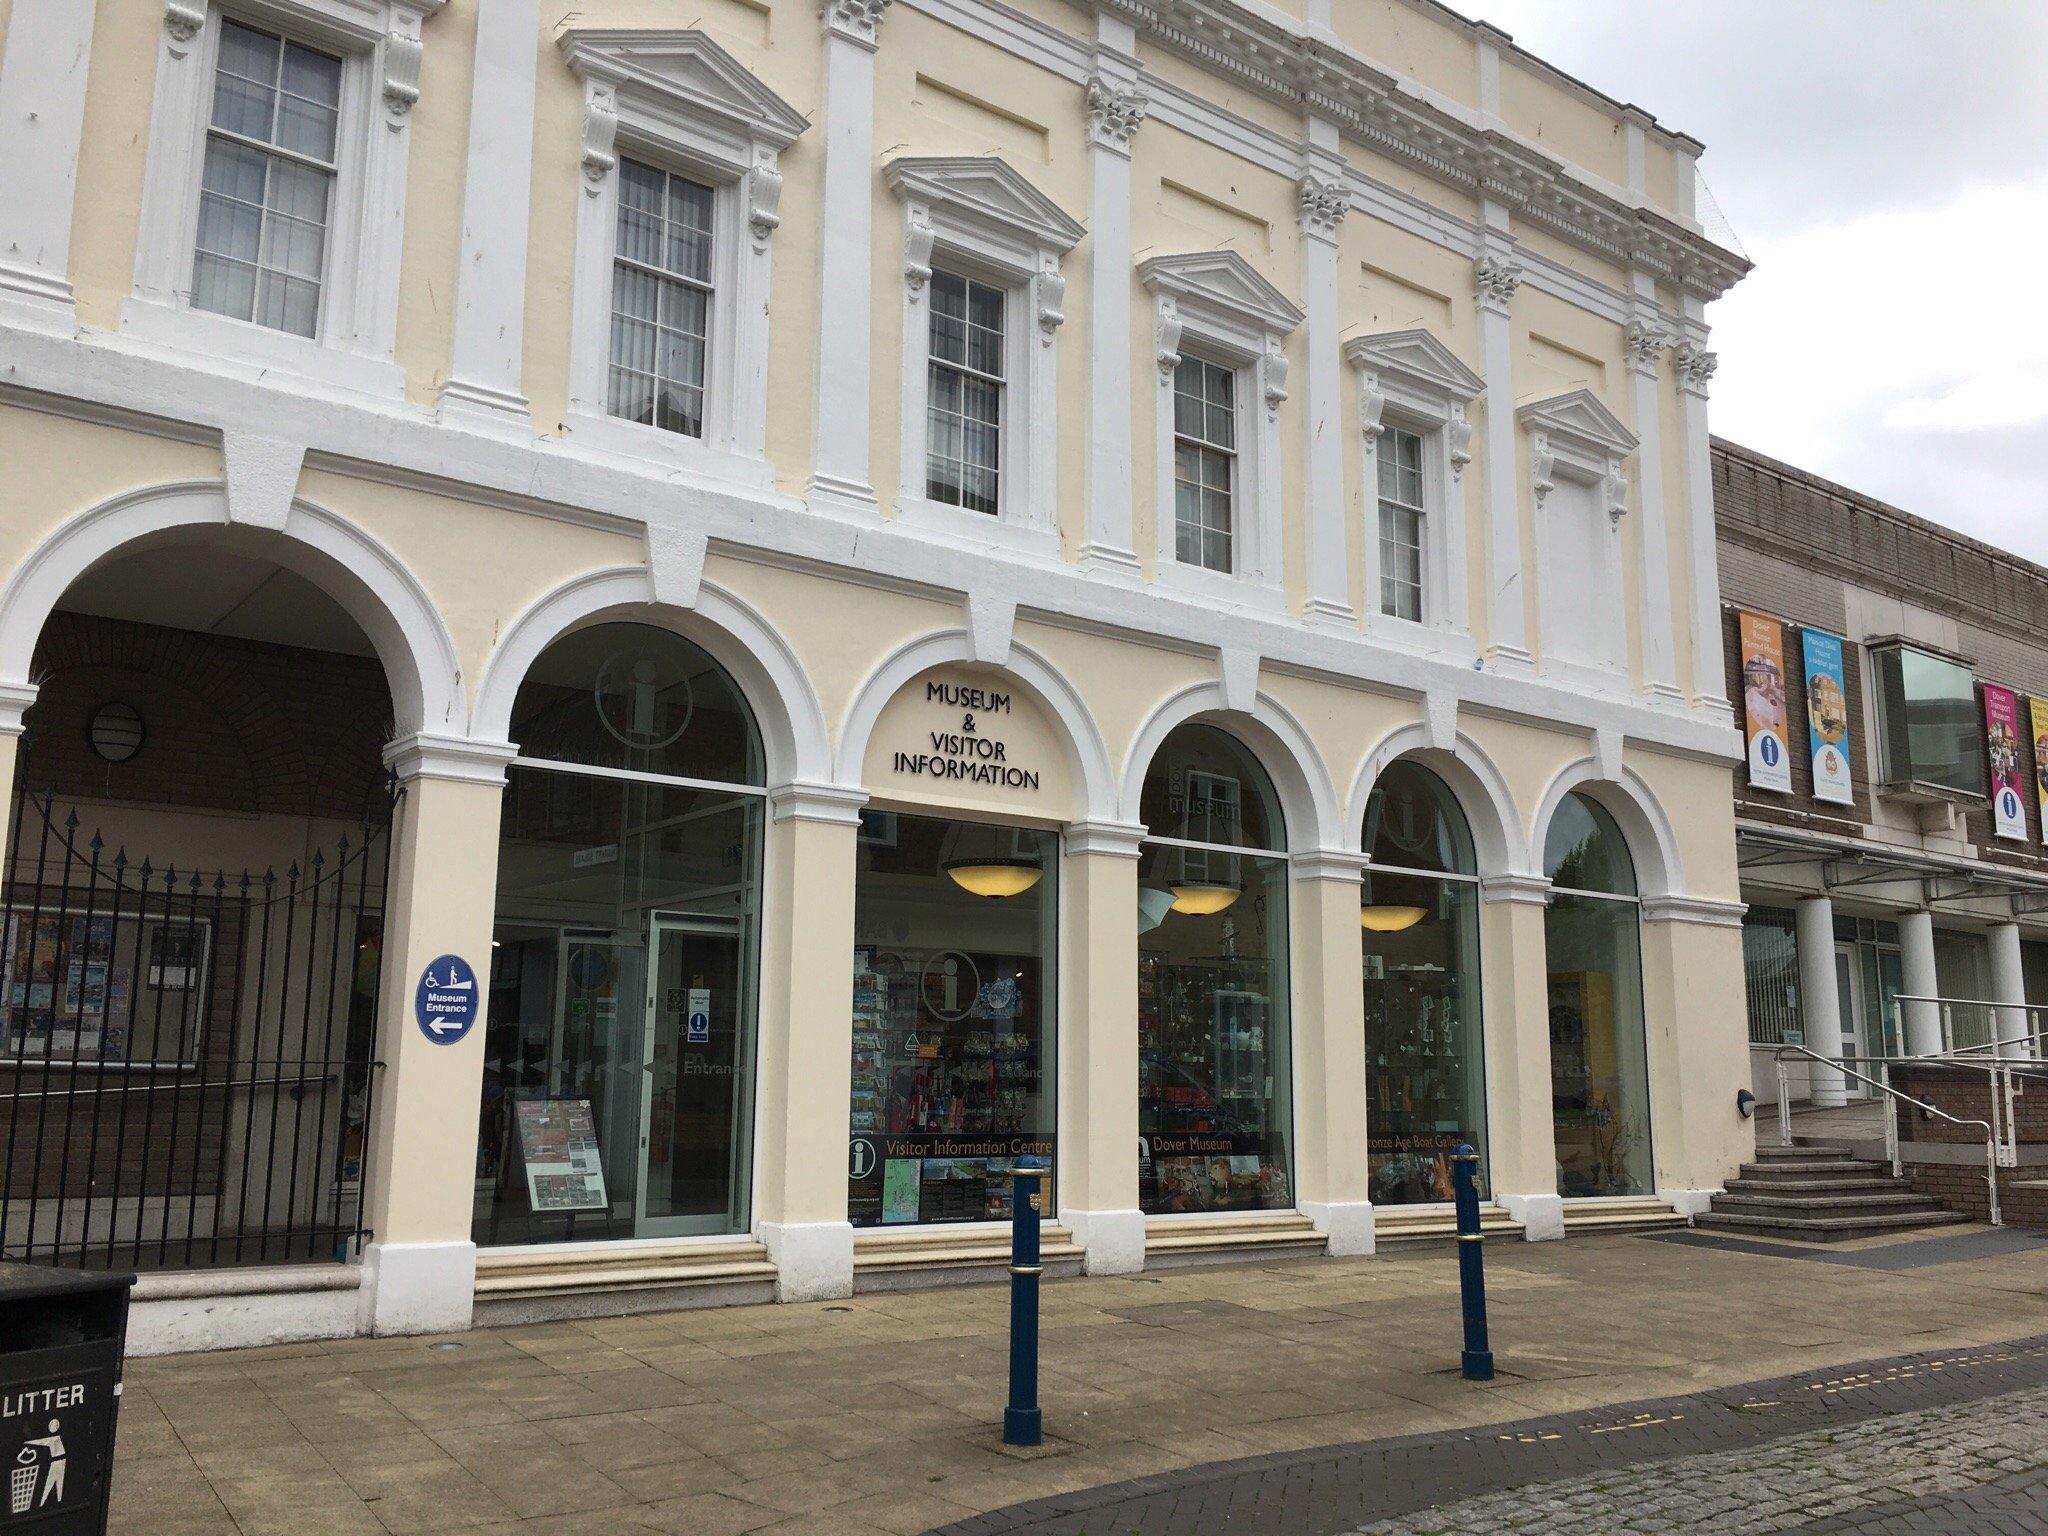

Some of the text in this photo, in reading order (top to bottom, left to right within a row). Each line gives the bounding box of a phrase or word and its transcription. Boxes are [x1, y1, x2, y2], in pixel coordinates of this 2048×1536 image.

[927, 681, 1011, 714] MUSEUM
[963, 713, 976, 732] &
[931, 731, 1006, 761] VISITOR
[894, 752, 1039, 790] INFORMATION
[428, 993, 467, 1002] Museum
[426, 1003, 467, 1013] Entrance
[887, 1138, 1053, 1156] Visitor Information Centre
[1153, 1136, 1232, 1151] Dover Museum
[1367, 1134, 1464, 1152] ronze Age Boat Gallery
[3, 1384, 85, 1418] LITTER
